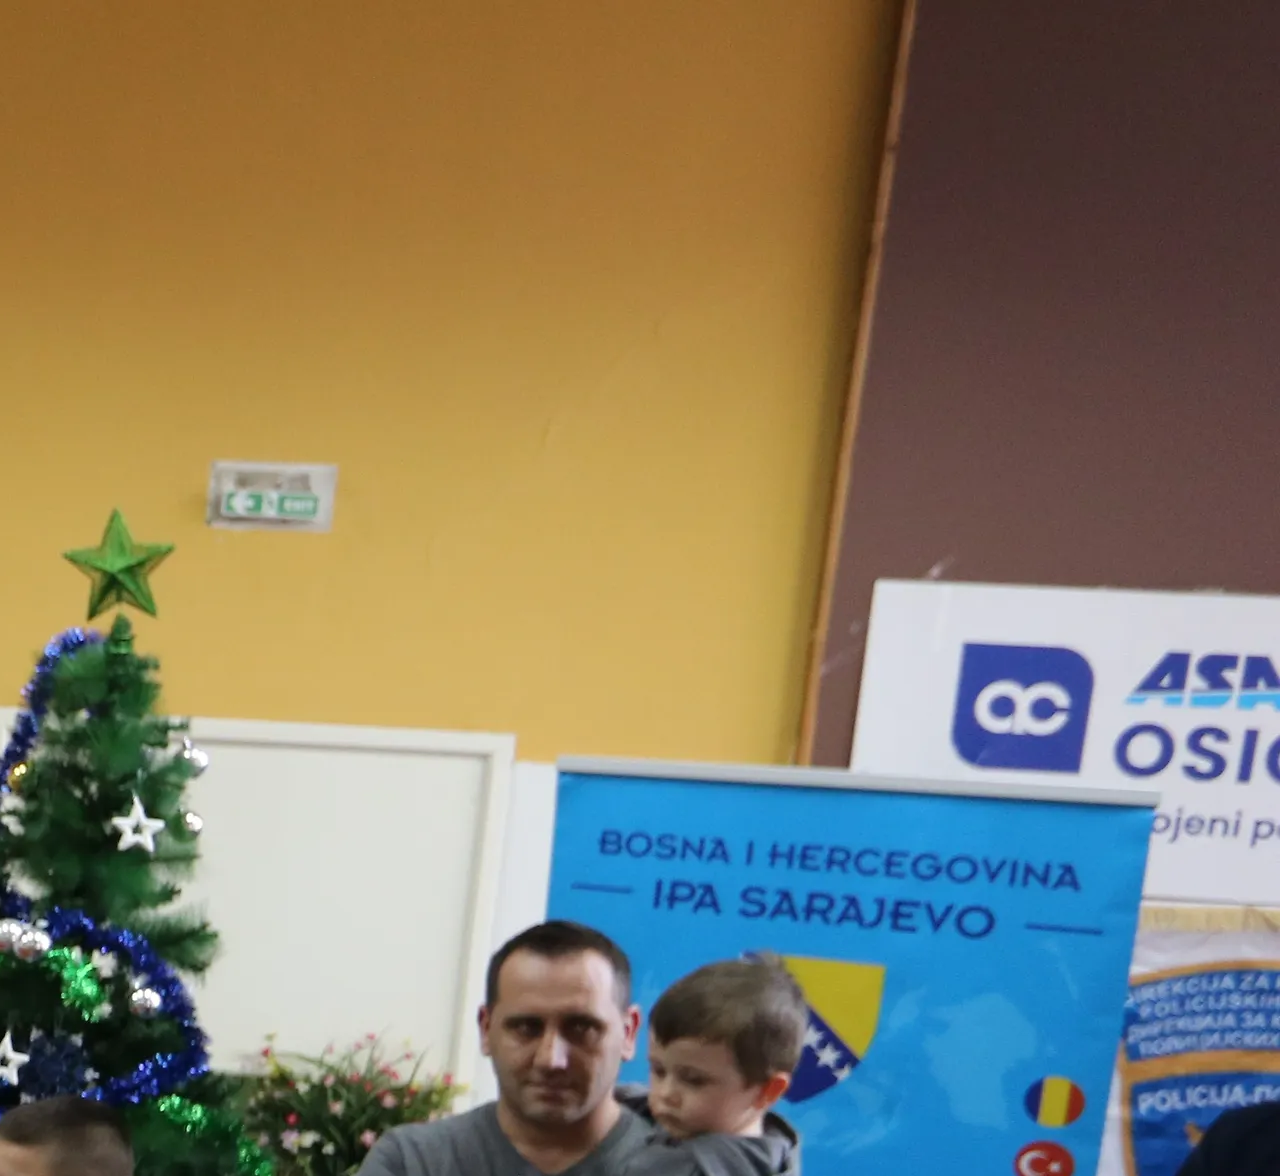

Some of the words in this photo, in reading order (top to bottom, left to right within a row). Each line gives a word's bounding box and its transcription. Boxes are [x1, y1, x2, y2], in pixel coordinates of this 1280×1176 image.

[1114, 723, 1280, 784] OSI
[1151, 809, 1242, 844] ojeni
[598, 829, 732, 866] BOSNA
[745, 841, 753, 867] I
[769, 843, 1082, 892] HERCEGOVINA
[652, 879, 722, 916] IPA
[739, 886, 996, 940] SARAJEVO
